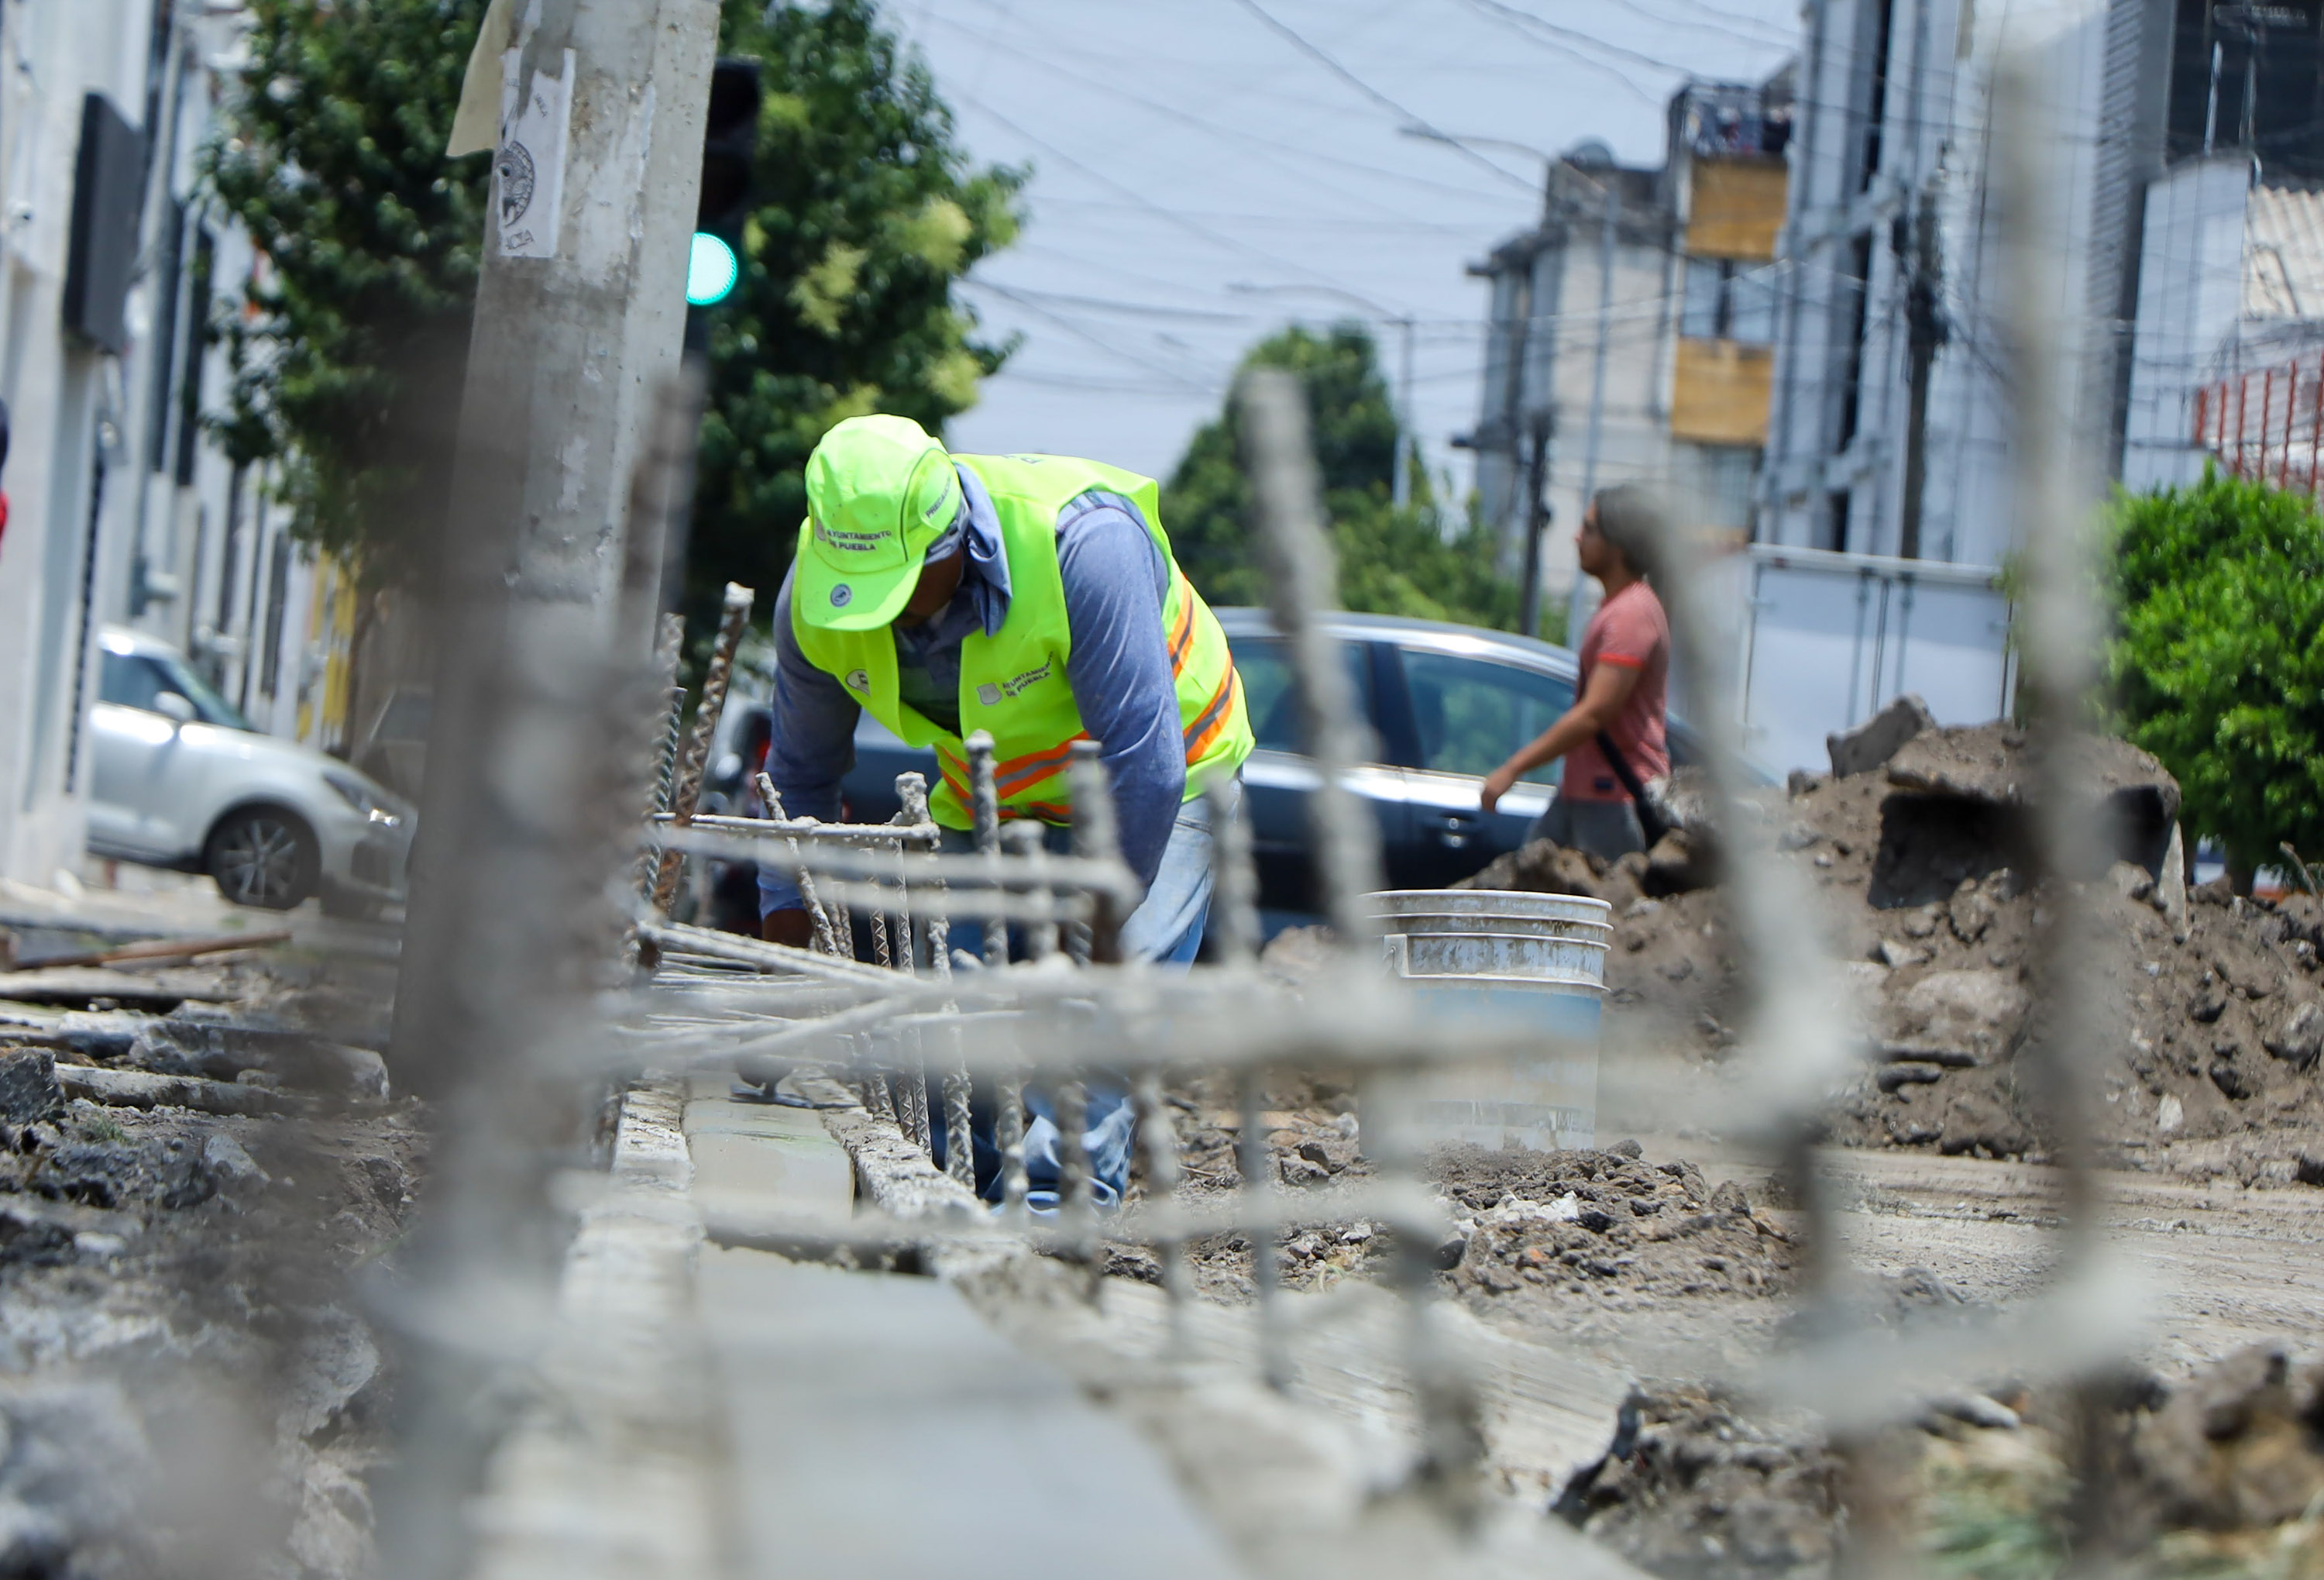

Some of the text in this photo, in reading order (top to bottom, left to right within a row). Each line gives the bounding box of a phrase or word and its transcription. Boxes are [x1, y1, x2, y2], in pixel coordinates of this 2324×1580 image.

[827, 529, 892, 540] AYUNTAMIENTO
[839, 542, 876, 551] PUEBLA
[1016, 672, 1050, 692] PUEBLA
